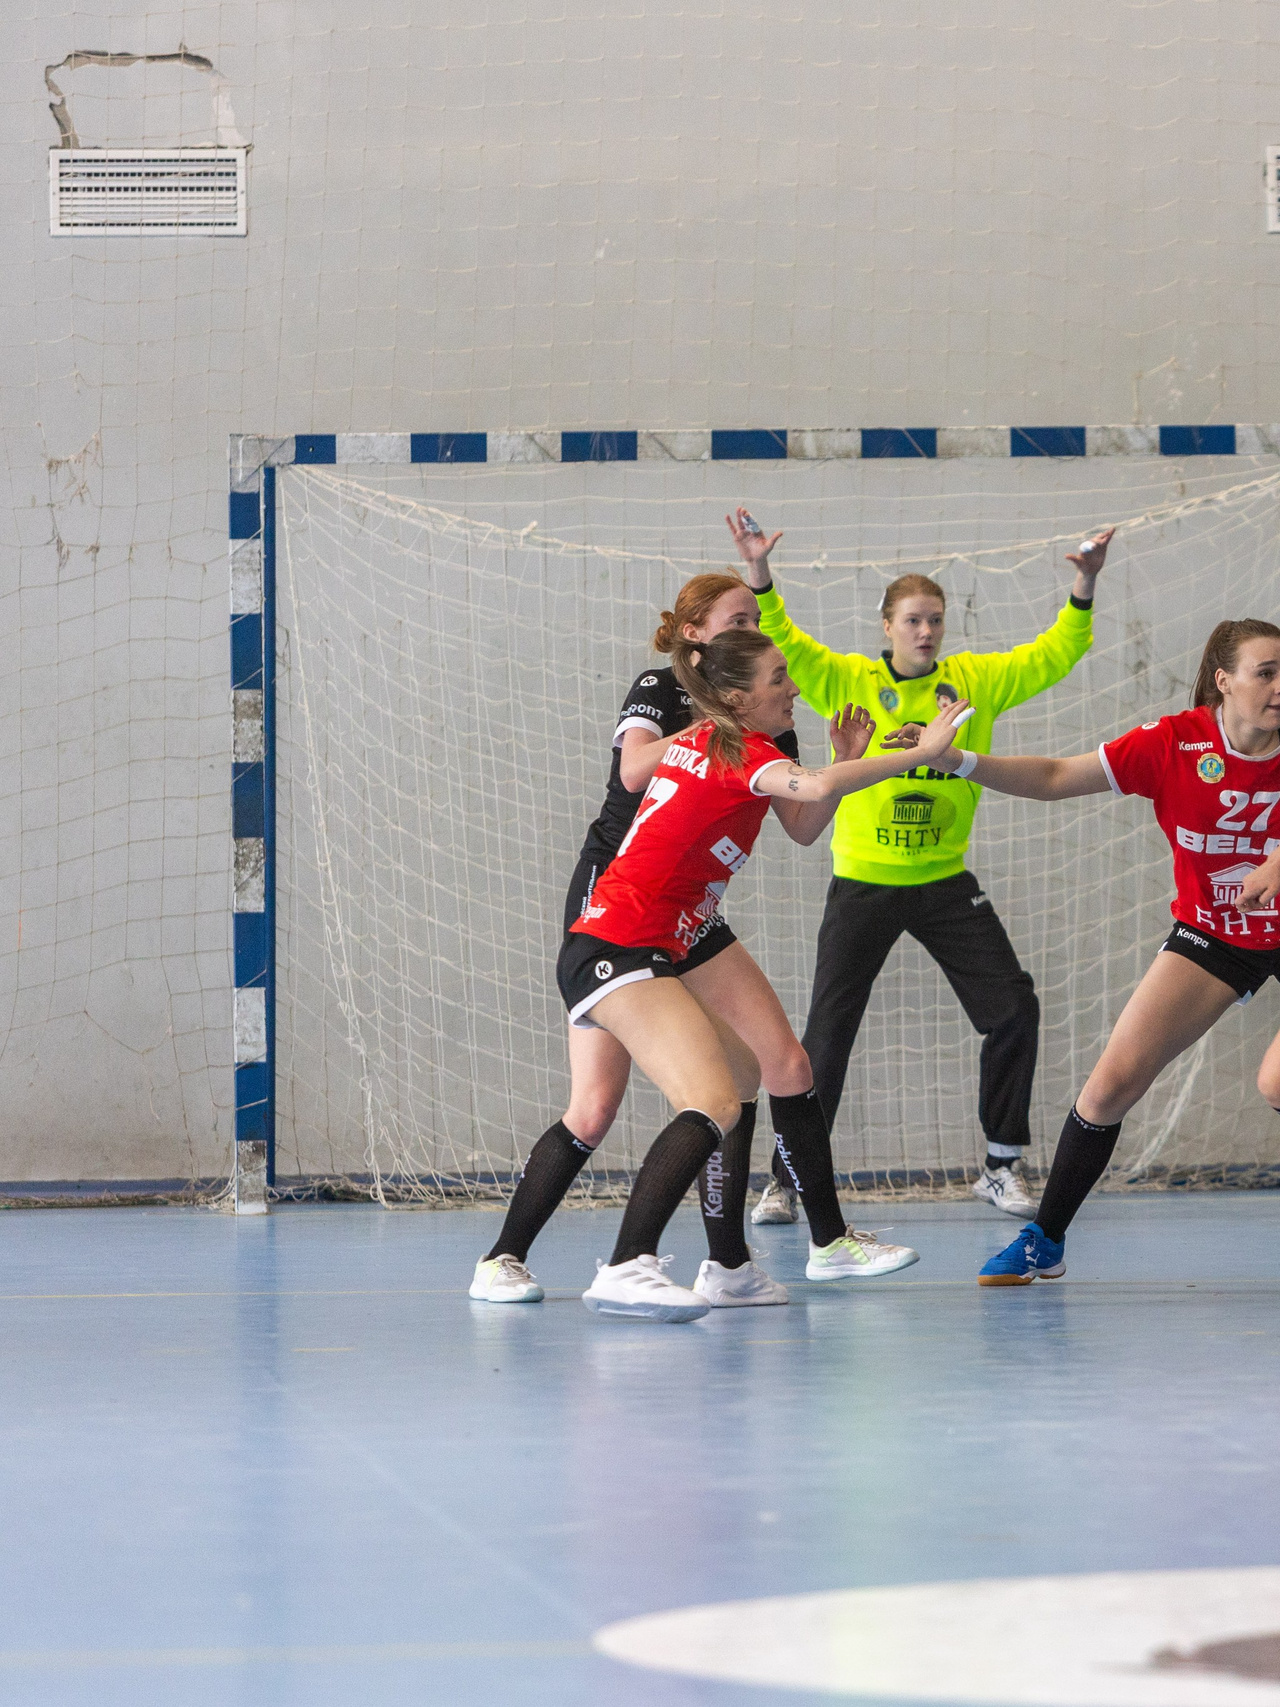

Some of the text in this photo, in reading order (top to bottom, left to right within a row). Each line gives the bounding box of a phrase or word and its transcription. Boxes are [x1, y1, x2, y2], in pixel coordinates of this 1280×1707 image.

[1178, 741, 1214, 752] Kempa
[617, 776, 679, 857] 7
[1216, 789, 1280, 832] 27
[876, 827, 942, 848] БНТУ
[1176, 927, 1209, 949] Kempa
